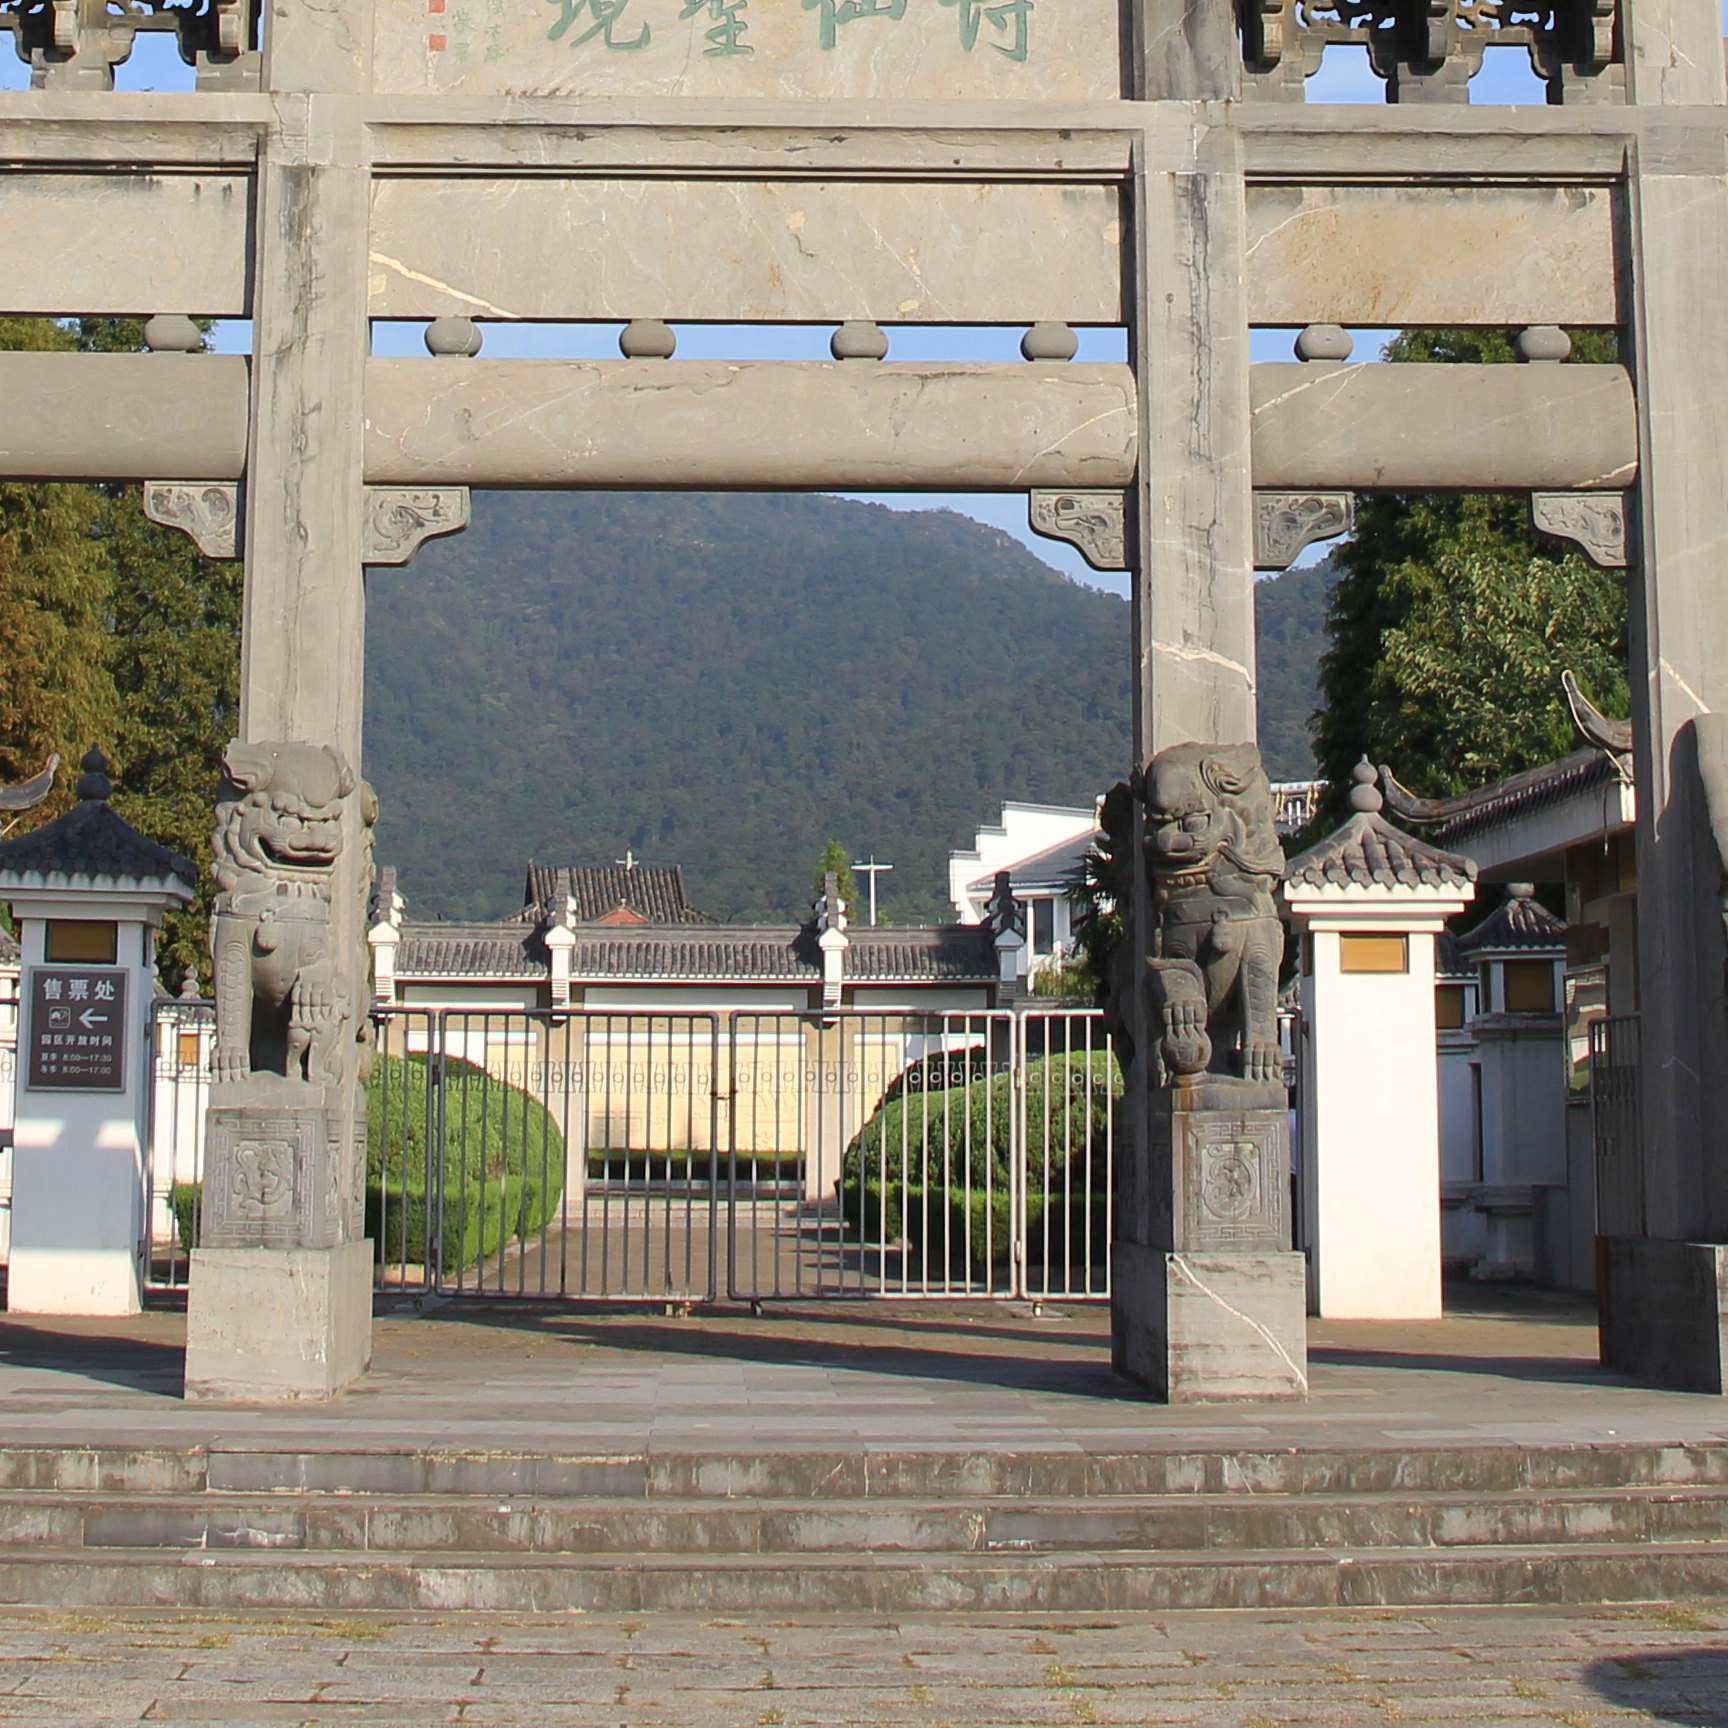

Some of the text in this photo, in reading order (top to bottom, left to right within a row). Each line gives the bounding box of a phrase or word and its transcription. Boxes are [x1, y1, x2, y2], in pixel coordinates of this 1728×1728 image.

[43, 977, 115, 1001] 售票处
[41, 1034, 113, 1046] 园区开放时间
